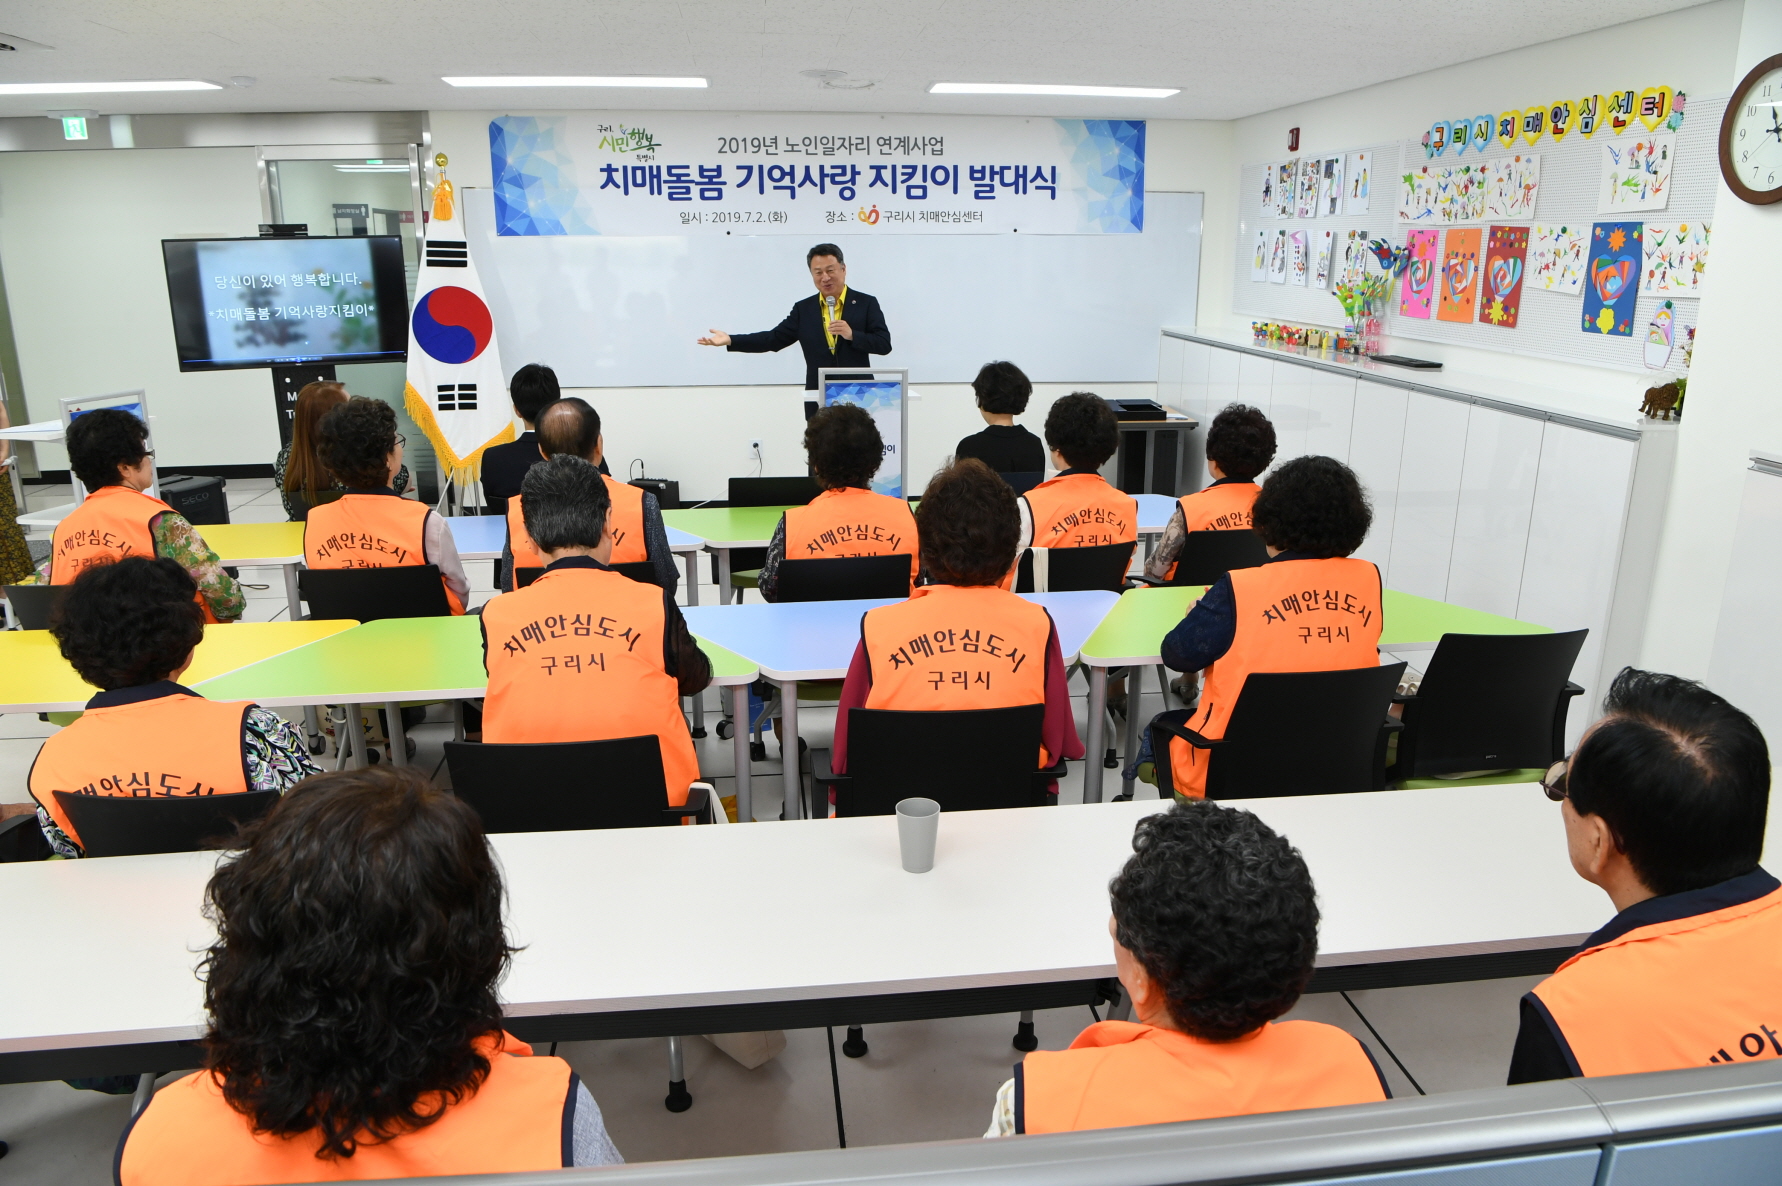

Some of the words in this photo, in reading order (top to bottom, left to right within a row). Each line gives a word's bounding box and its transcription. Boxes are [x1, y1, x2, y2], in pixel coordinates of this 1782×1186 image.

[1762, 85, 1771, 97] 11
[1433, 120, 1489, 151] 구리시
[1499, 91, 1665, 136] 치매안심센터
[1747, 105, 1757, 117] 10
[1739, 128, 1746, 141] 9
[717, 136, 779, 156] 2019년
[783, 136, 870, 155] 노인일자리
[876, 136, 944, 156] 연계사업
[1741, 150, 1748, 163] 8
[600, 163, 727, 201] 치매돌봄
[735, 164, 861, 201] 기억사랑
[869, 164, 959, 200] 지킴이
[969, 165, 1057, 200] 발대식
[1752, 166, 1759, 179] 7
[1767, 171, 1775, 184] 6
[679, 211, 702, 224] 일시
[711, 211, 788, 224] 2019.7.2.(화)
[825, 211, 847, 224] 장소
[882, 211, 915, 223] 구리시
[918, 210, 983, 223] 치매안심센터
[214, 275, 257, 289] 당신이
[260, 274, 287, 288] 있어
[290, 272, 362, 287] 행복합니다.
[1051, 507, 1127, 536] 치매안심도시
[316, 532, 407, 563] 치매안심도시
[805, 524, 901, 555] 치매안심도시
[1074, 534, 1112, 547] 구리시
[1262, 589, 1372, 627] 치매안심도시
[503, 613, 641, 657] 치매안심도시
[1298, 626, 1350, 643] 구리시
[888, 628, 1026, 673] 치매안심도시
[541, 652, 605, 676] 구리시
[927, 670, 990, 690] 구리시
